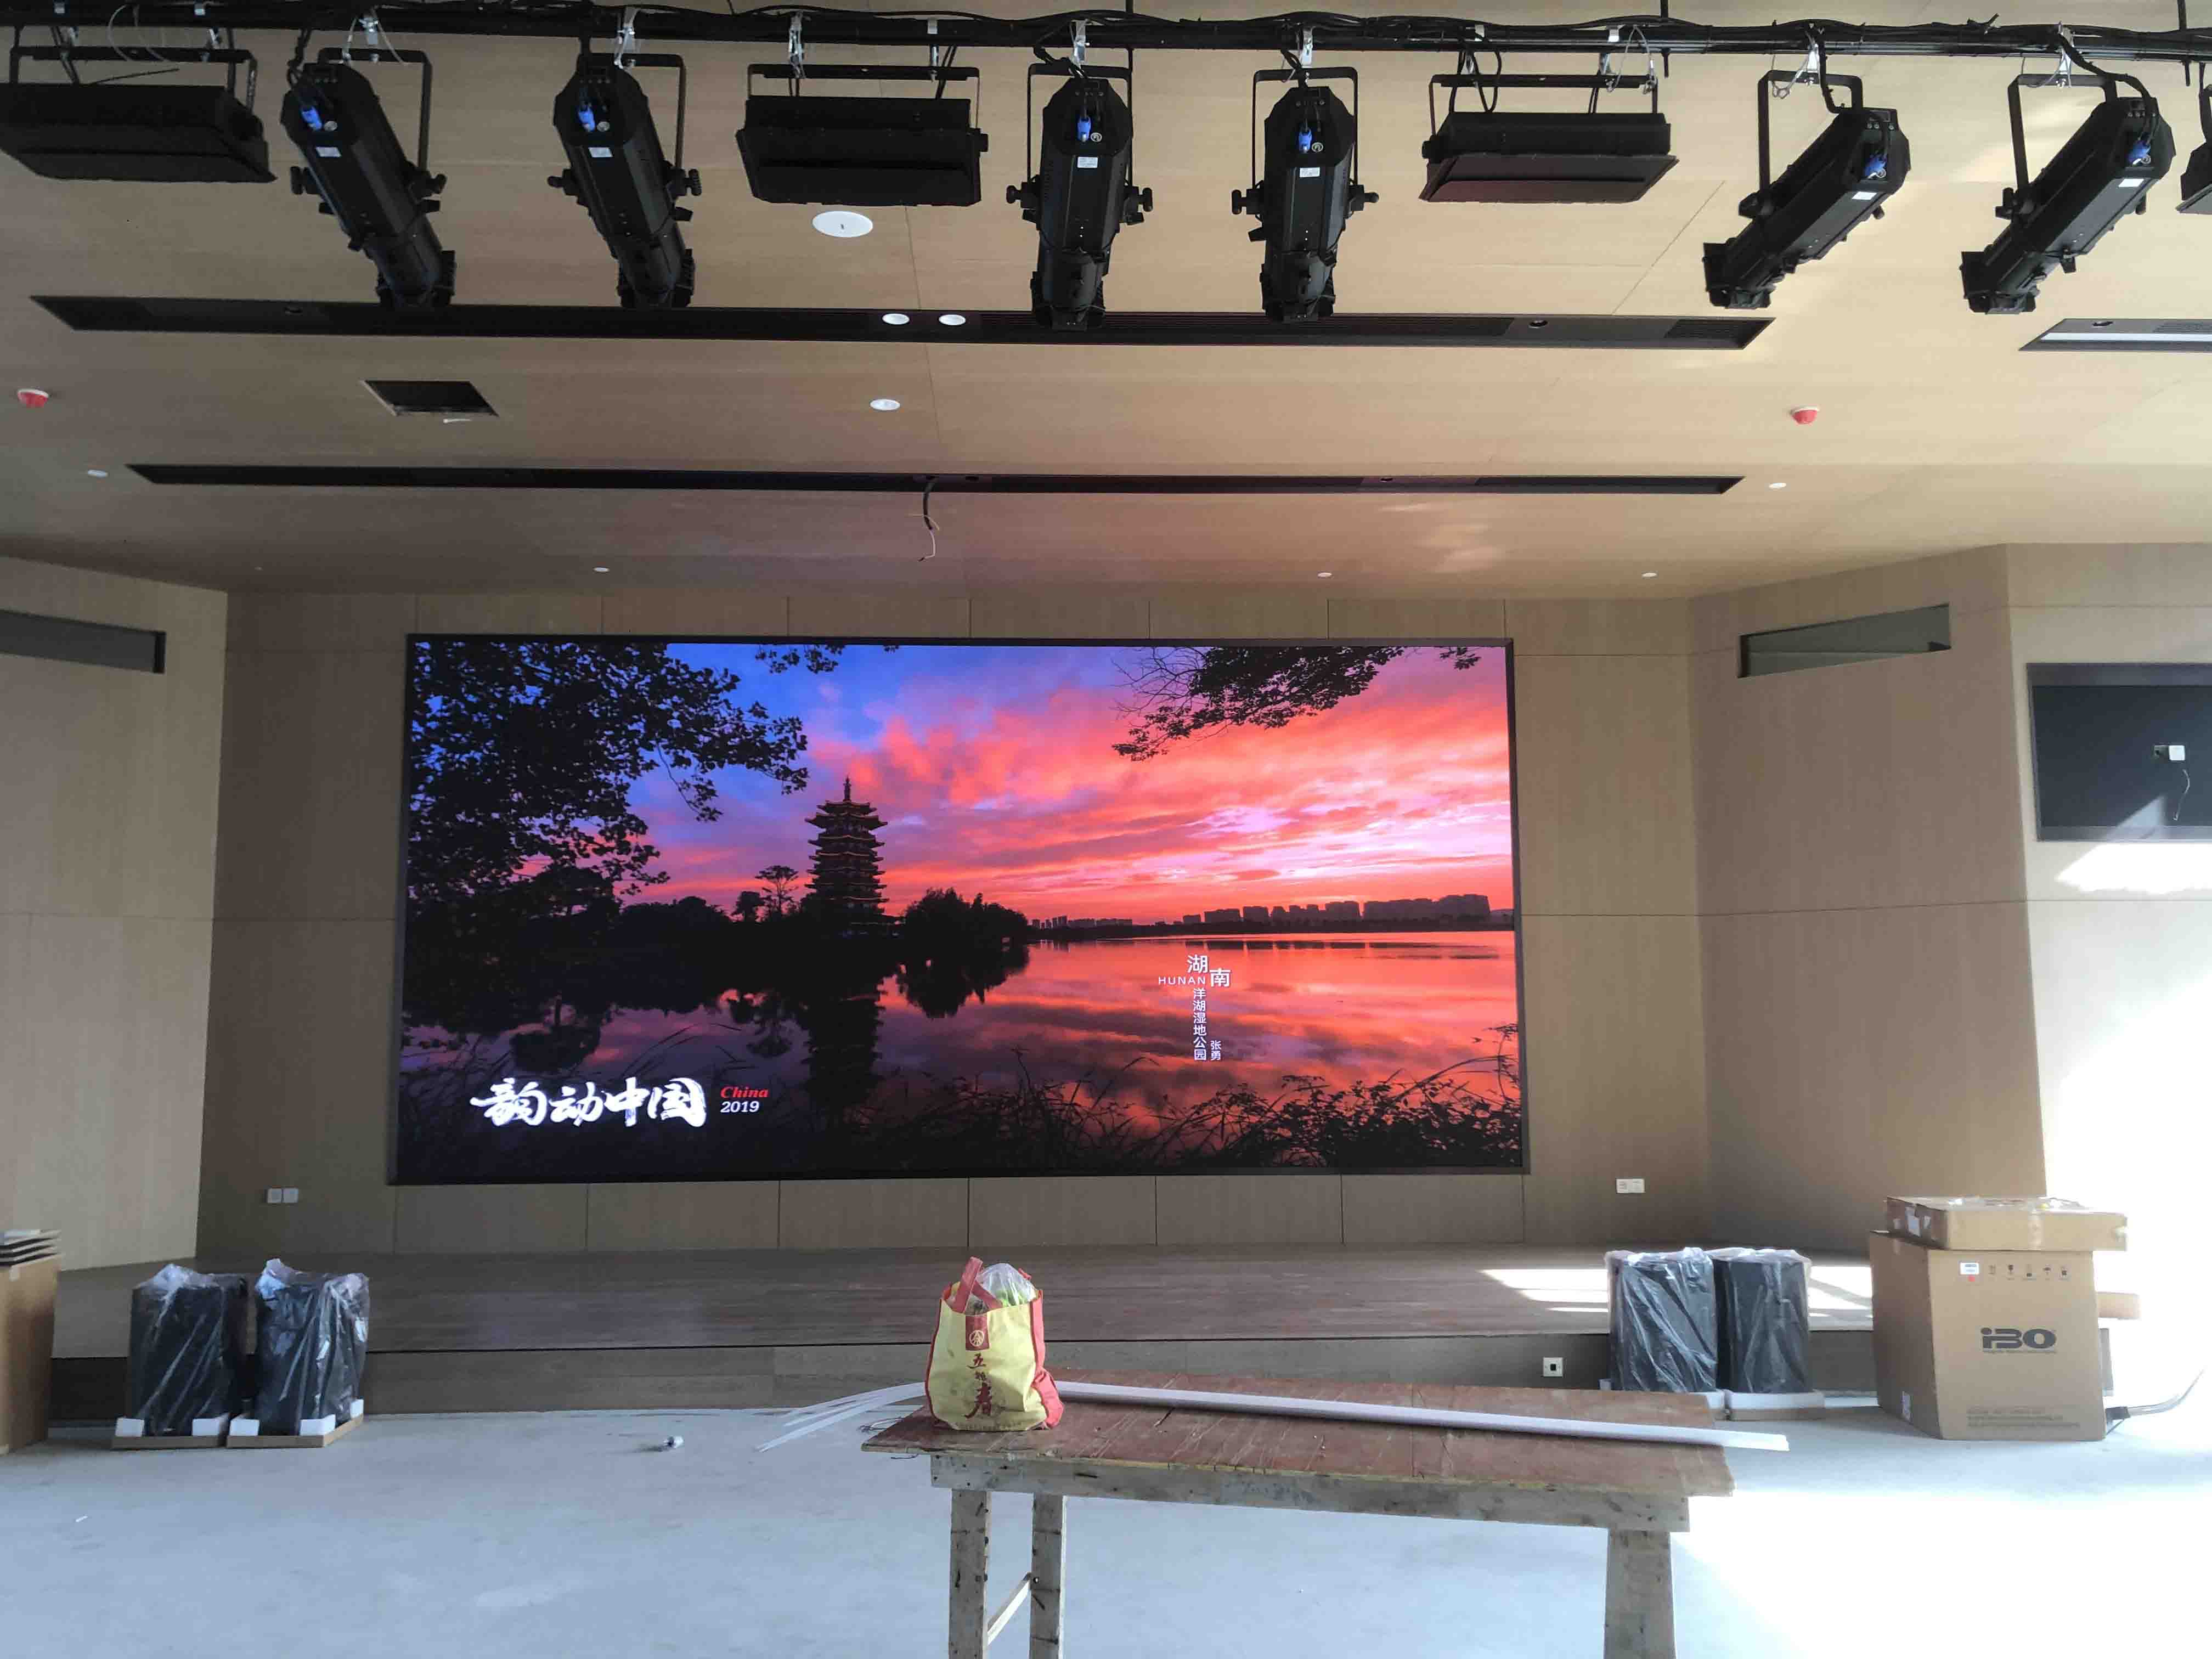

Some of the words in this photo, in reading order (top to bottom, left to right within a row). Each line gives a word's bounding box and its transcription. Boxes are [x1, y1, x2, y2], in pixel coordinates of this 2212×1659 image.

[1187, 954, 1231, 987] 湖南
[1158, 977, 1205, 985] HUNAN
[1193, 988, 1207, 1060] 洋湖湿地公园
[1210, 1040, 1221, 1060] 张勇
[720, 1085, 769, 1098] China
[470, 1077, 707, 1127] 韵动中国
[720, 1101, 759, 1113] 2019
